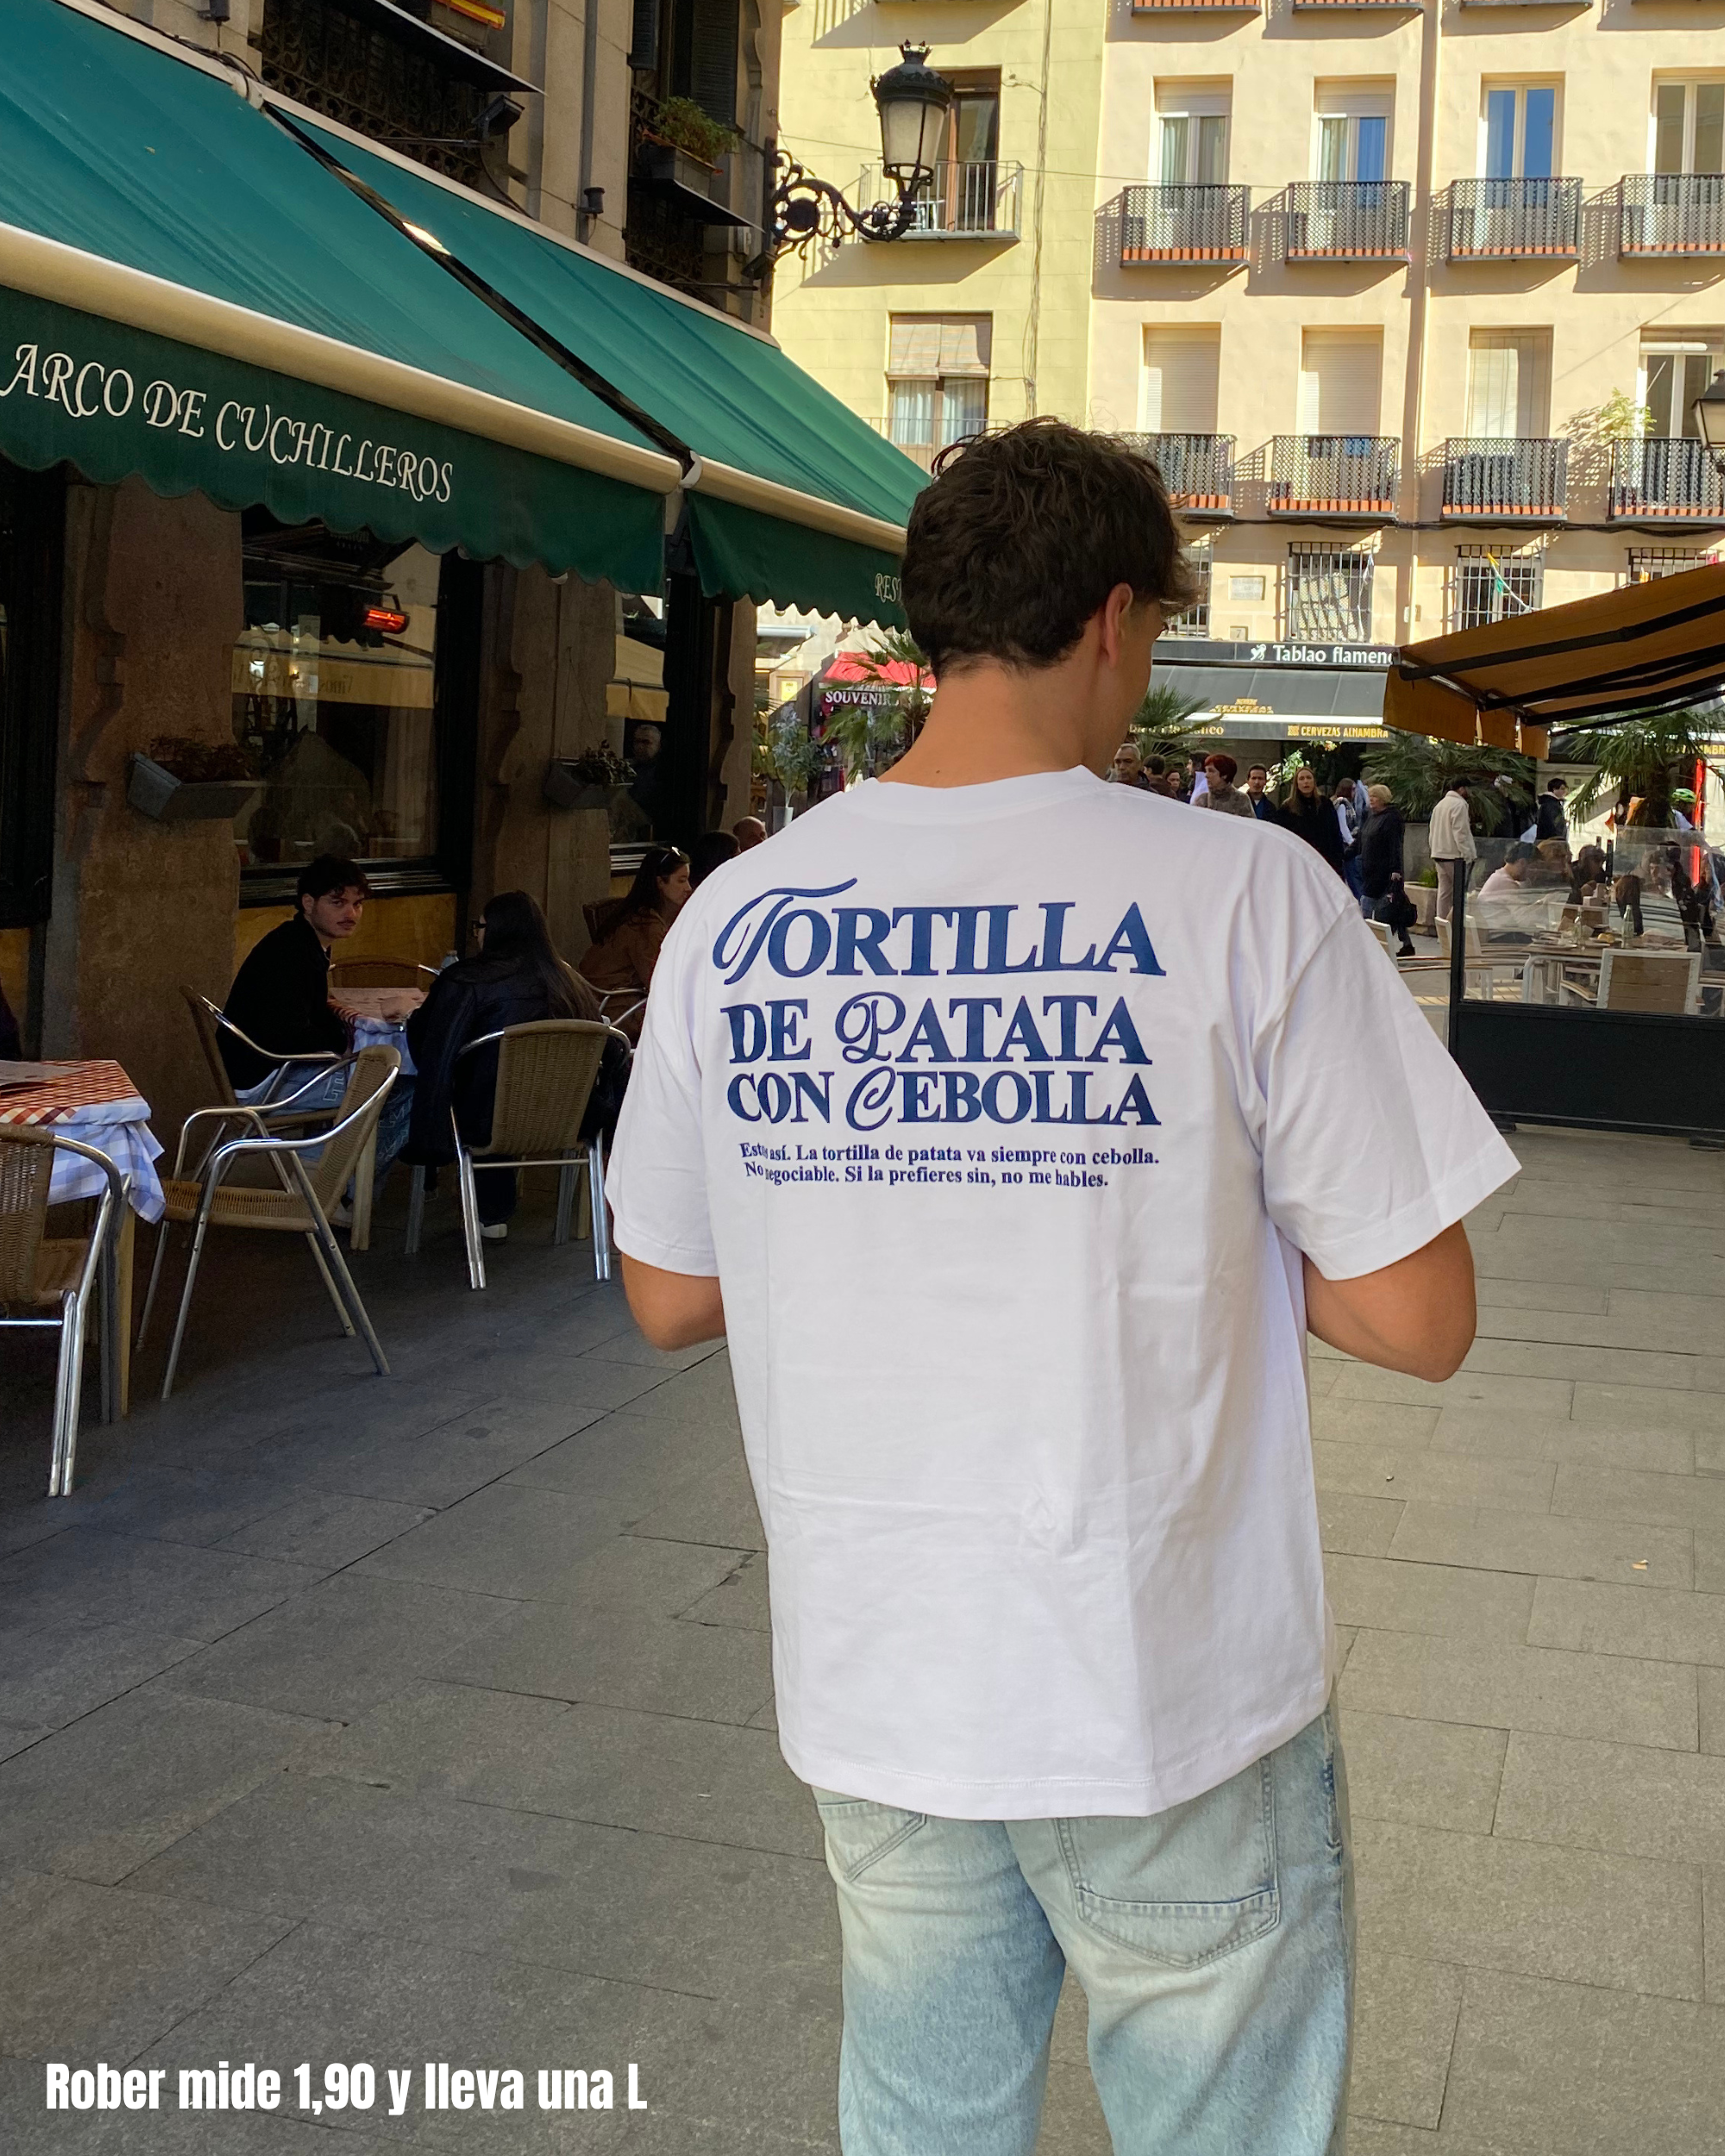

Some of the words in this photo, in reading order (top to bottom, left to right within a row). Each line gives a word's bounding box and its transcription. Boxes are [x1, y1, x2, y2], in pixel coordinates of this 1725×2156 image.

[0, 343, 135, 418] ARCO
[143, 379, 208, 439] DE
[216, 400, 454, 504] CUCHILLEROS
[1272, 643, 1327, 663] Tablao
[825, 690, 899, 706] SOUVENIR
[1301, 725, 1341, 737] CERVEZAS
[1343, 727, 1389, 738] ALHAMBRA
[712, 877, 1167, 985] TORTILLA
[719, 999, 812, 1064] DE
[835, 991, 1153, 1065] PATATA
[727, 1071, 835, 1124] CON
[845, 1066, 1162, 1131] CEBOLLA
[769, 1144, 792, 1161] así.
[796, 1144, 818, 1161] La
[822, 1144, 880, 1161] tortilla
[885, 1144, 903, 1161] de
[908, 1145, 963, 1166] patata
[966, 1148, 986, 1163] va
[991, 1146, 1057, 1166] siempre
[1059, 1150, 1087, 1165] con
[1092, 1148, 1160, 1165] cebolla.
[743, 1161, 764, 1177] No
[844, 1165, 862, 1182] Si
[868, 1165, 884, 1181] la
[888, 1166, 963, 1186] prefieres
[967, 1167, 996, 1188] sin,
[1001, 1170, 1023, 1184] no
[1028, 1171, 1051, 1185] me
[1056, 1169, 1109, 1188] hables.
